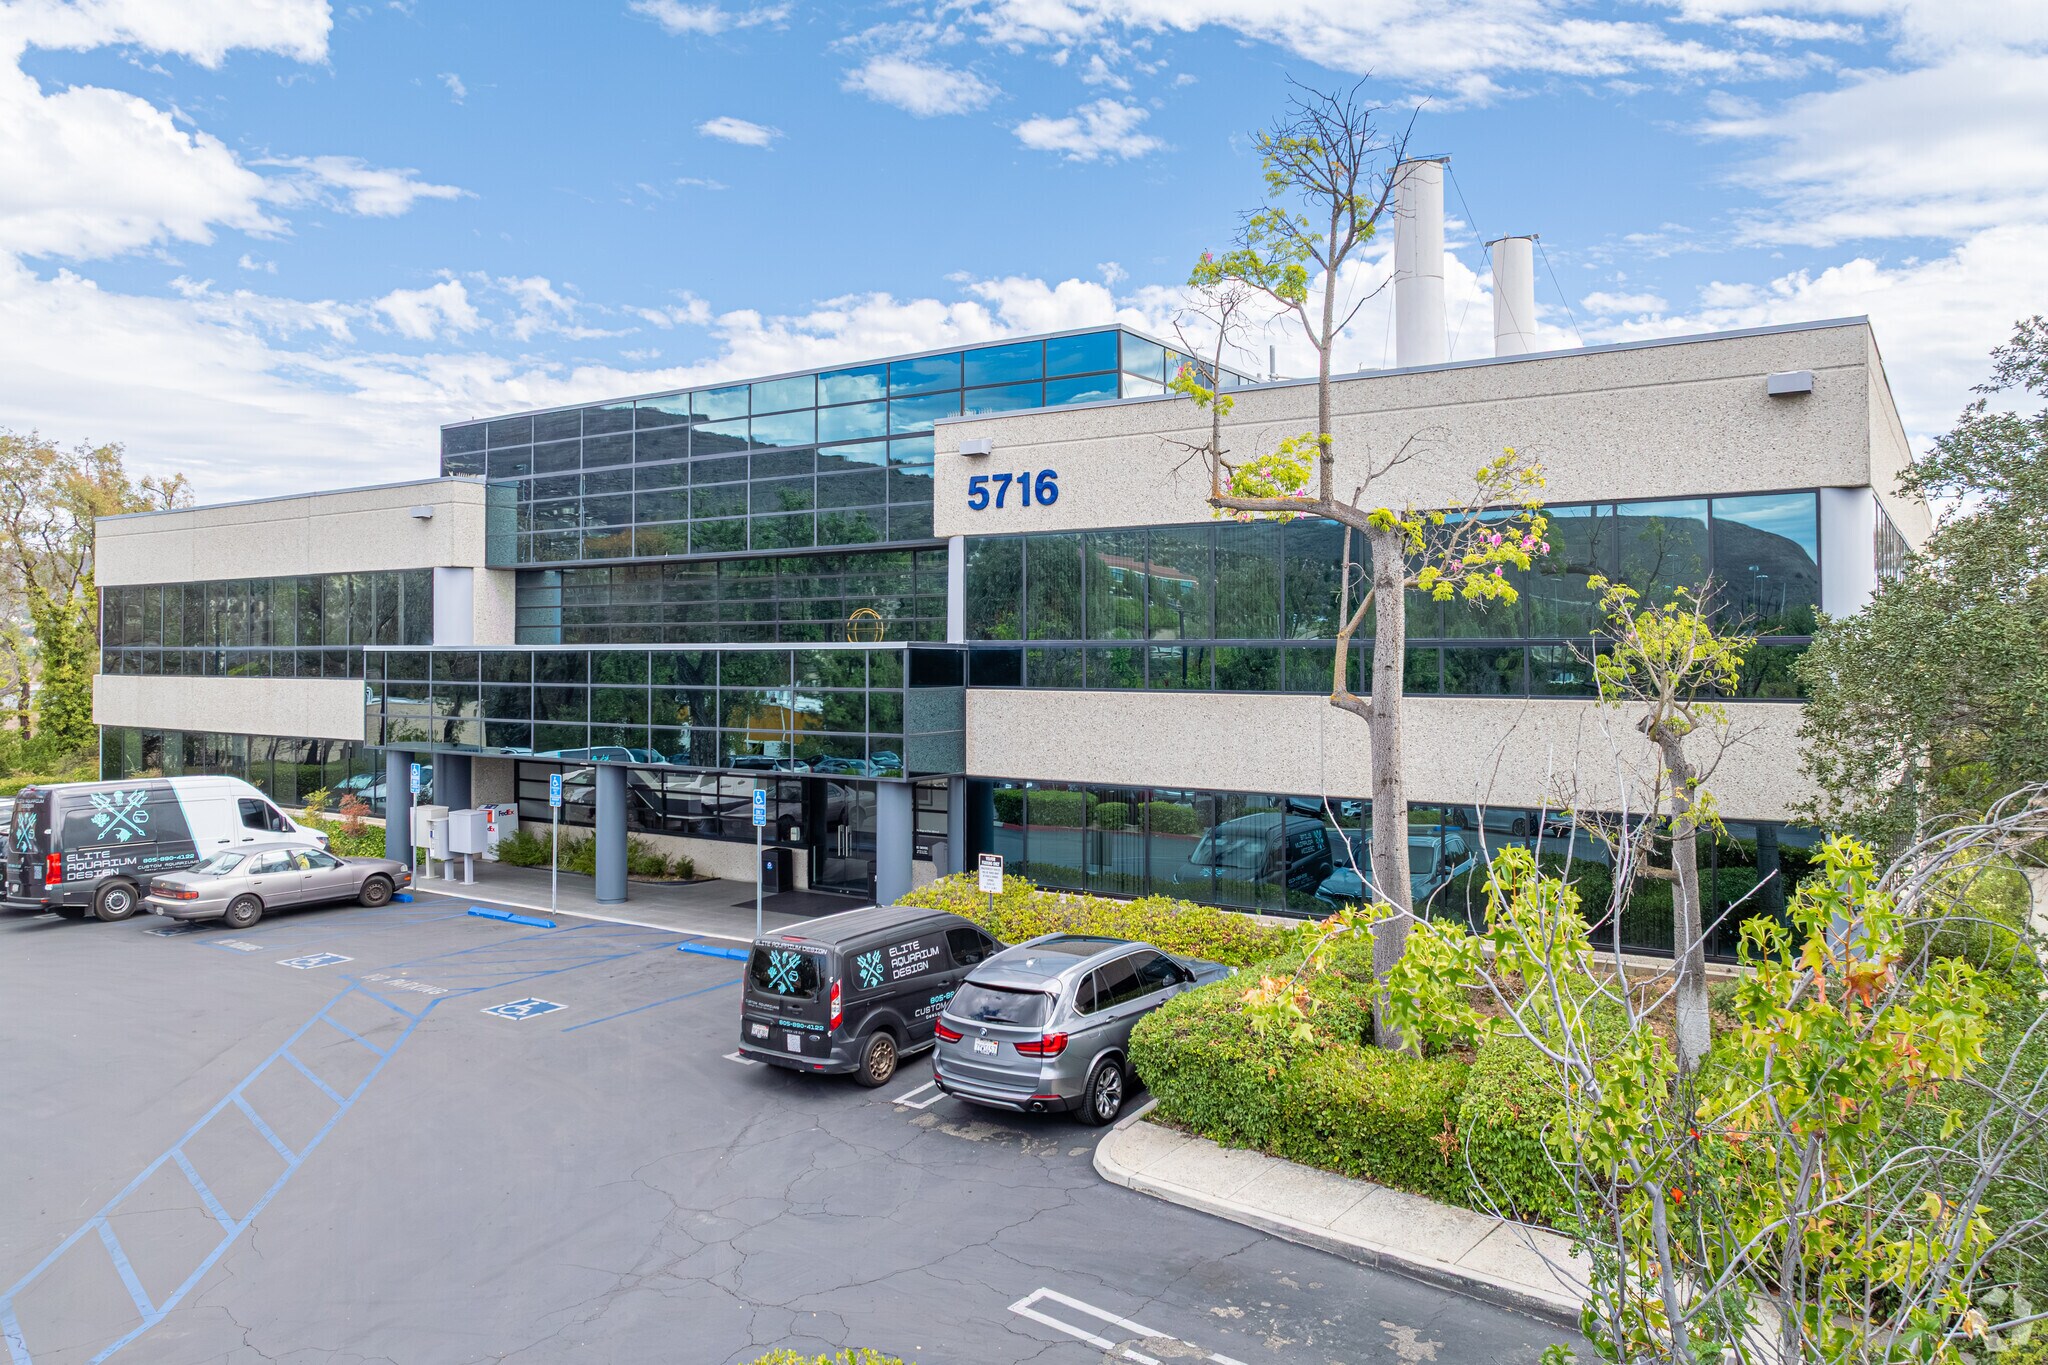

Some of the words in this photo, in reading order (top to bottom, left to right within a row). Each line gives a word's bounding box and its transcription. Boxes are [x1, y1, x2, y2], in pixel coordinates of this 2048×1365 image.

[968, 469, 1059, 511] 5716
[498, 809, 515, 817] FedEx
[66, 850, 111, 862] ELITE
[67, 857, 137, 872] AQUARIUM
[67, 868, 119, 880] DESIGN
[771, 941, 801, 951] AQUARIUM
[802, 945, 828, 955] DESIGN
[888, 940, 920, 957] ELITE
[891, 946, 940, 969] AQUARIUM
[892, 960, 929, 980] DESIGN
[914, 1001, 947, 1017] CUSTOM
[778, 1019, 824, 1032] 805-890-4122
